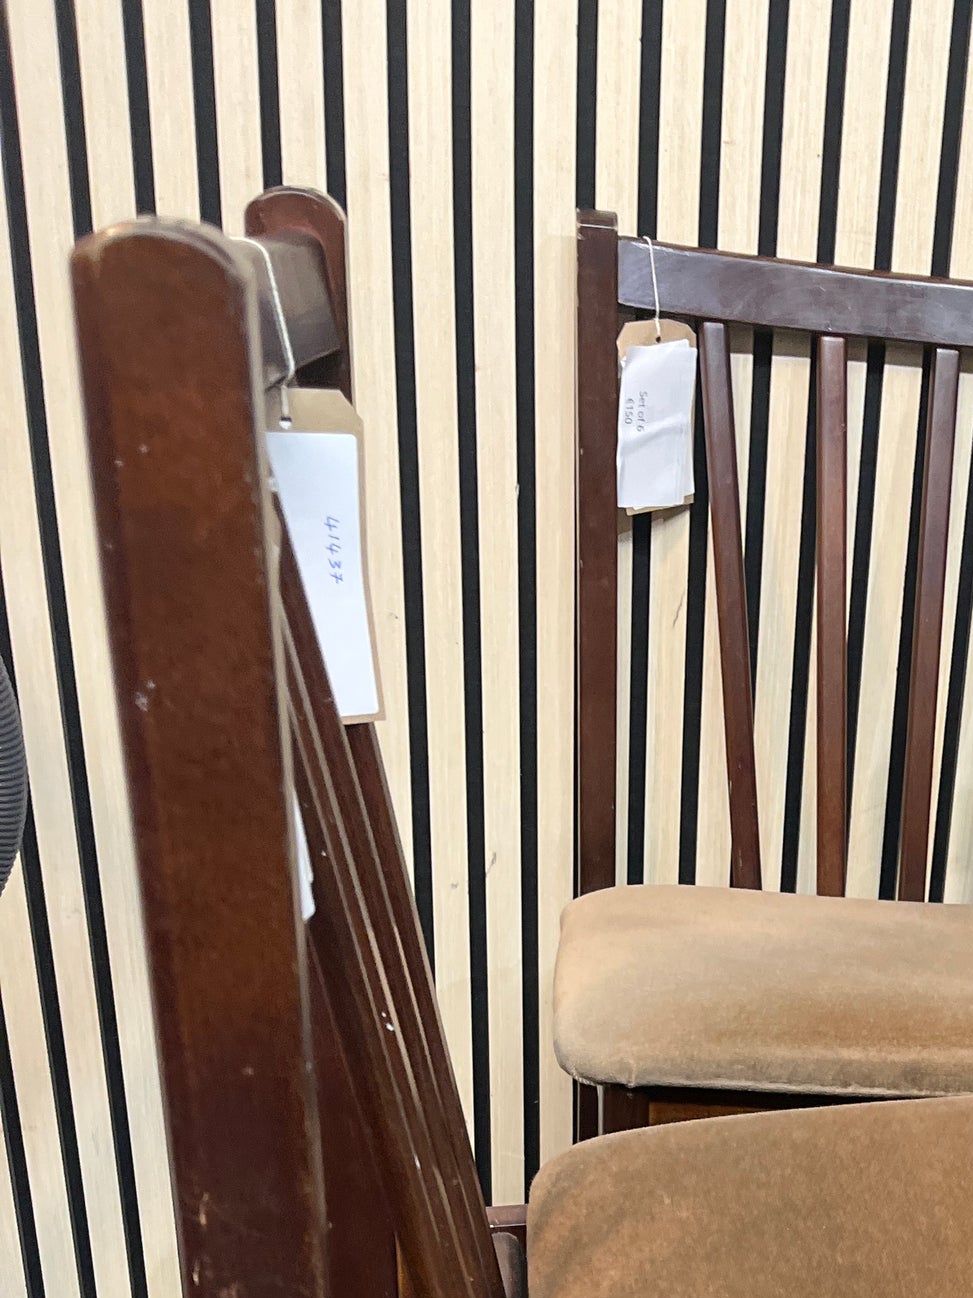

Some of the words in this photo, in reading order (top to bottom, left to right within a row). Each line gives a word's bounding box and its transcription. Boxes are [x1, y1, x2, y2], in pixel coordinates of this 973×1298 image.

[639, 391, 648, 408] Set
[637, 411, 646, 422] of
[322, 514, 344, 585] 41437
